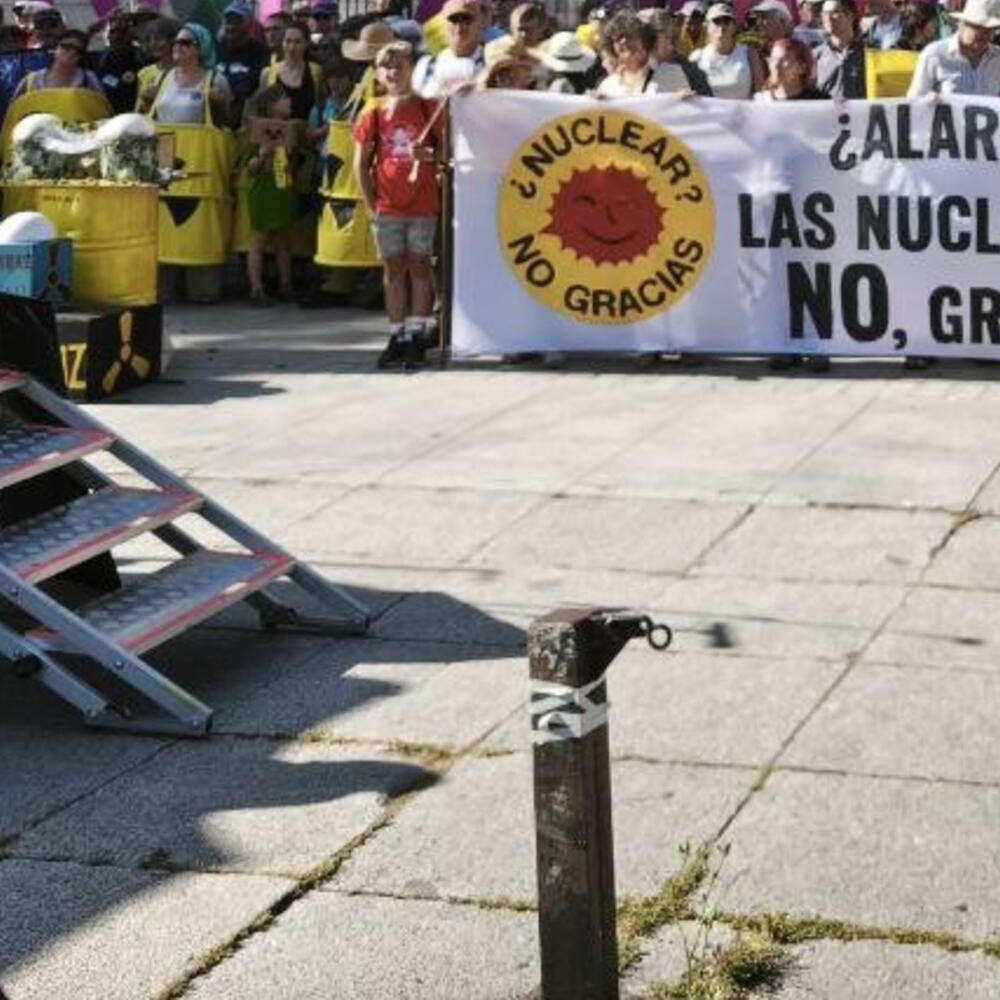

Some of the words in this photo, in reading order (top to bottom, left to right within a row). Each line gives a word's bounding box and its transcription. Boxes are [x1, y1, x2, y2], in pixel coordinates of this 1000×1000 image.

[510, 115, 703, 203] ¿NUCLEAR?
[738, 193, 836, 250] LAS
[508, 234, 556, 288] NO
[564, 238, 704, 317] GRACIAS
[786, 262, 908, 350] NO,
